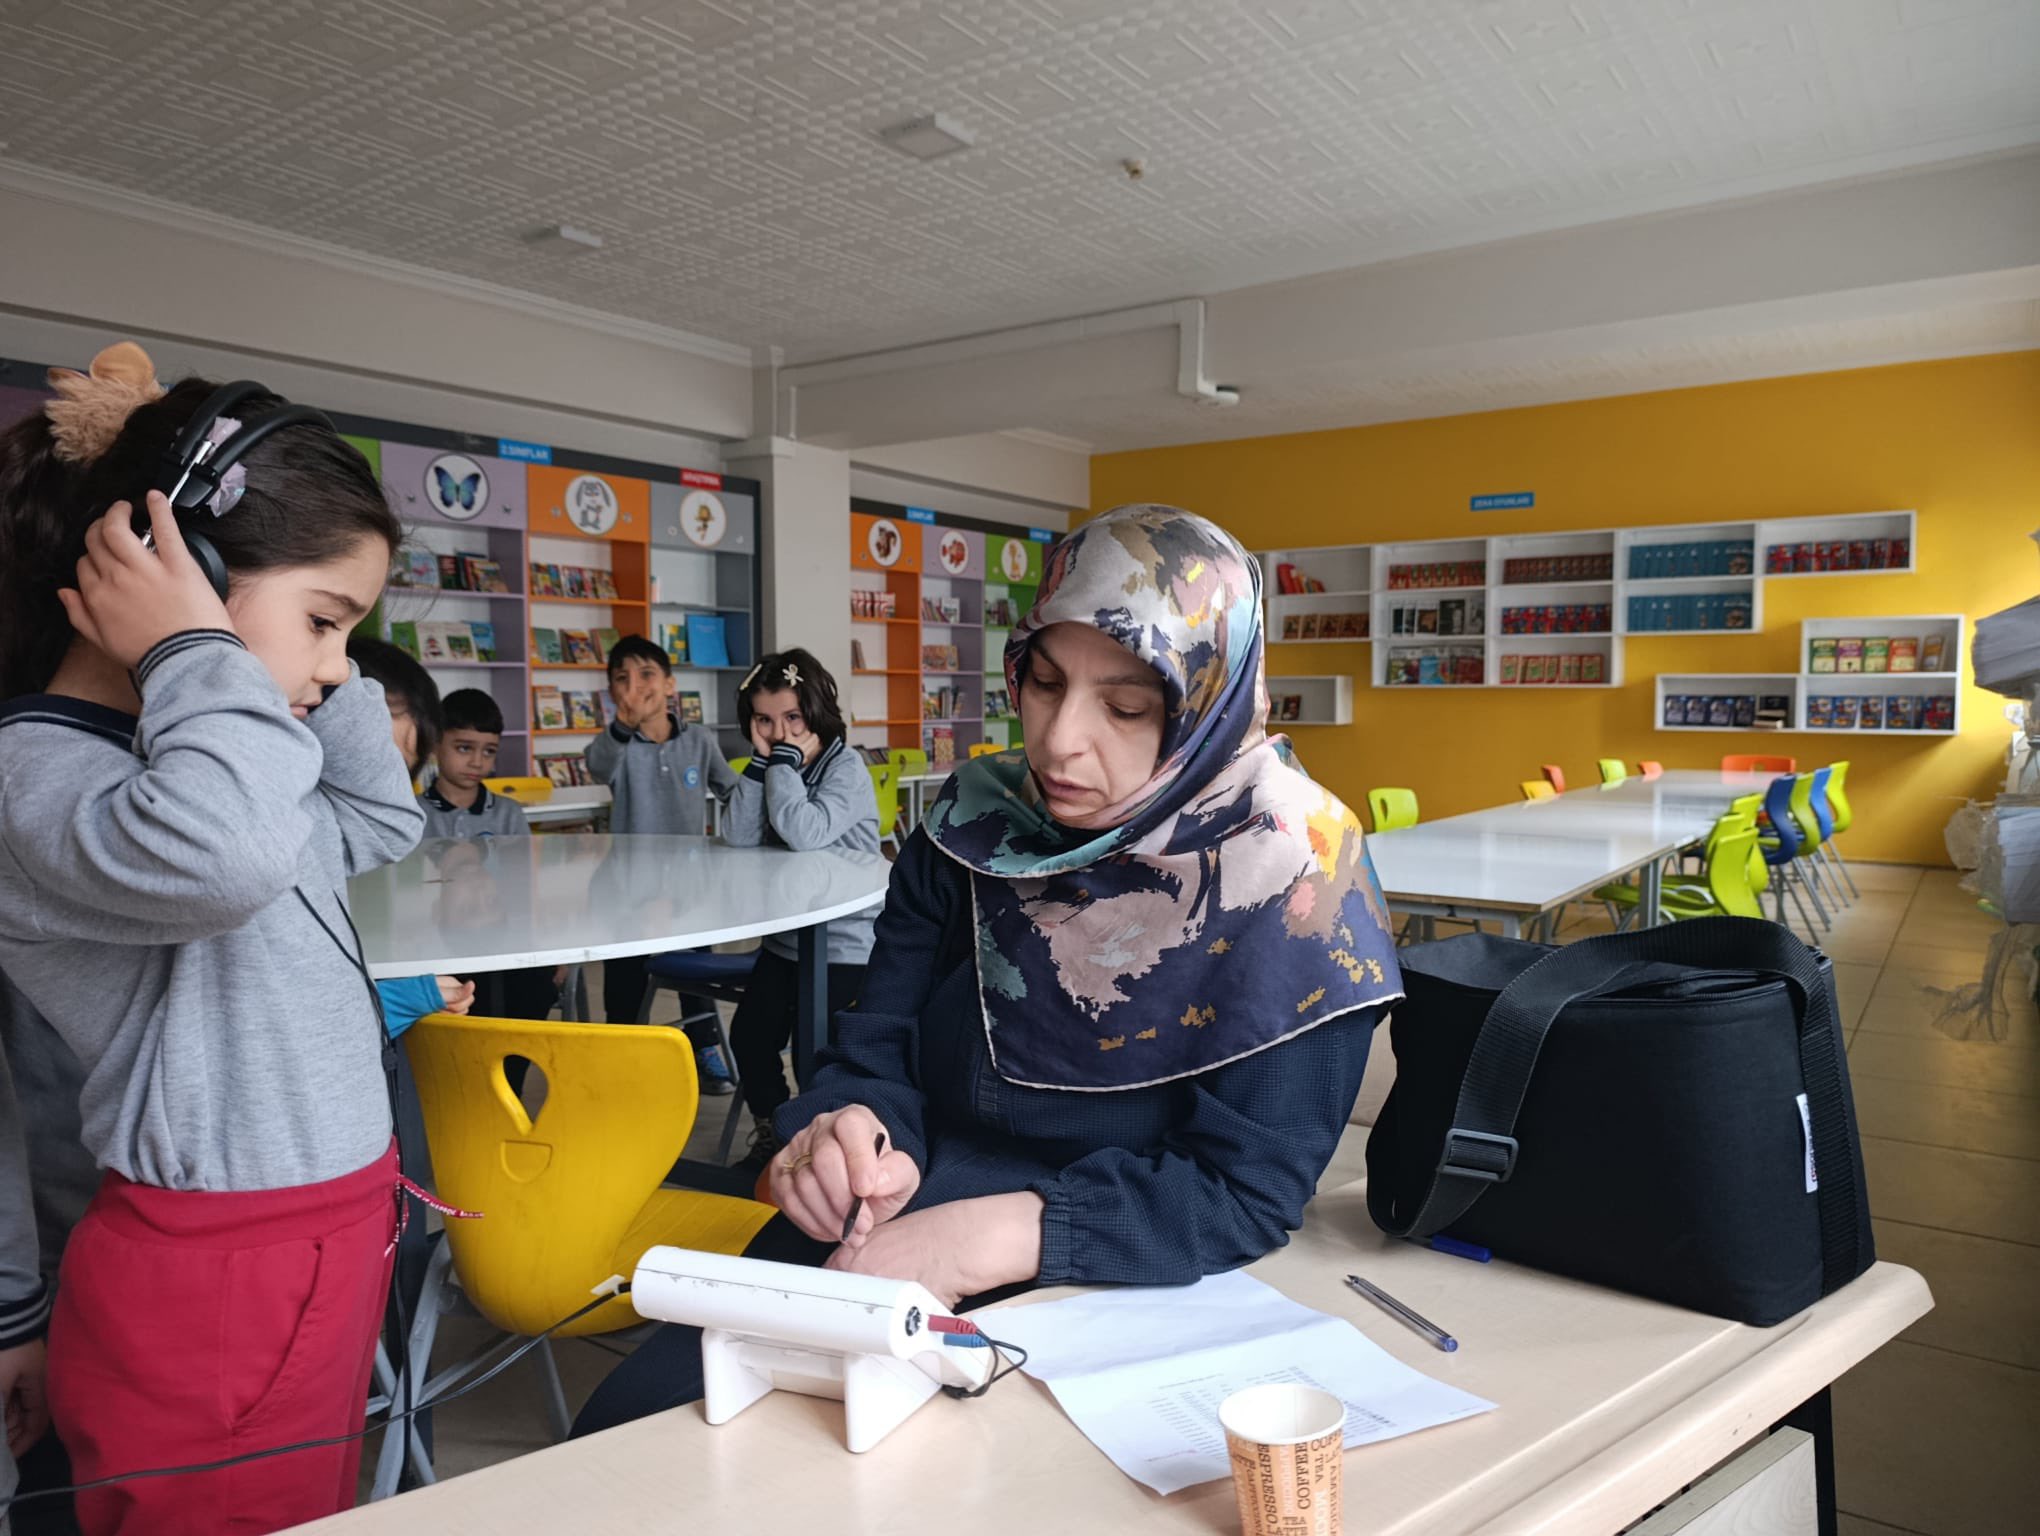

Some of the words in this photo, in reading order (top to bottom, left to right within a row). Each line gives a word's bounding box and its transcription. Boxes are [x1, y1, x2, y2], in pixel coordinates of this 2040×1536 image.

[1257, 1443, 1279, 1525] ESPRESSO
[1295, 1442, 1311, 1510] COFFEE
[1315, 1453, 1325, 1483] TEA
[1282, 1516, 1307, 1525] TEA
